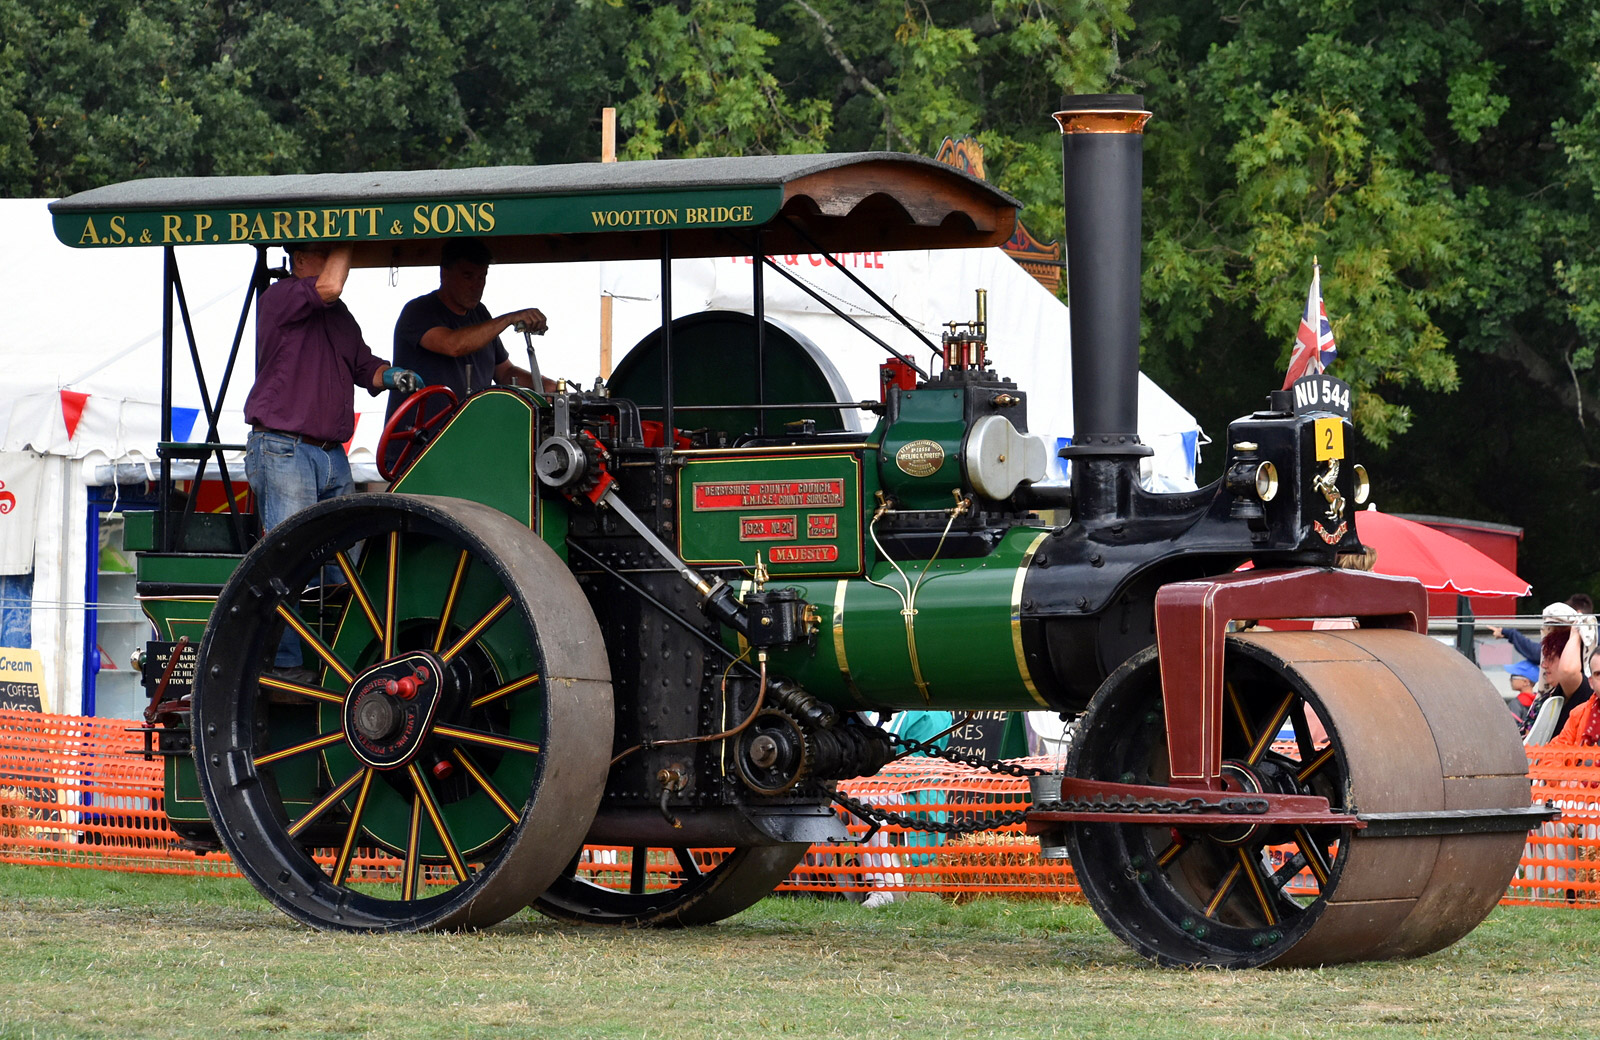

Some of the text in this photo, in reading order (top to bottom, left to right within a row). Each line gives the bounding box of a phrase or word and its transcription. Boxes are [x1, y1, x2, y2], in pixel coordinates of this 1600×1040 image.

[79, 203, 495, 244] A.S. & R.P. BARRETT & SONS
[591, 205, 754, 227] WOOTTON BRIDGE
[1294, 380, 1350, 412] NU 544
[1324, 428, 1334, 450] 2
[704, 483, 833, 496] DERBYSHIRE COUNTY COUNCIL
[778, 495, 804, 505] COUNTY
[805, 493, 840, 504] SURVEYOR
[776, 547, 829, 561] MAJESTY
[0, 656, 33, 672] Cream
[7, 684, 40, 698] COFFEE
[2, 701, 36, 712] AKES
[952, 724, 984, 740] KES
